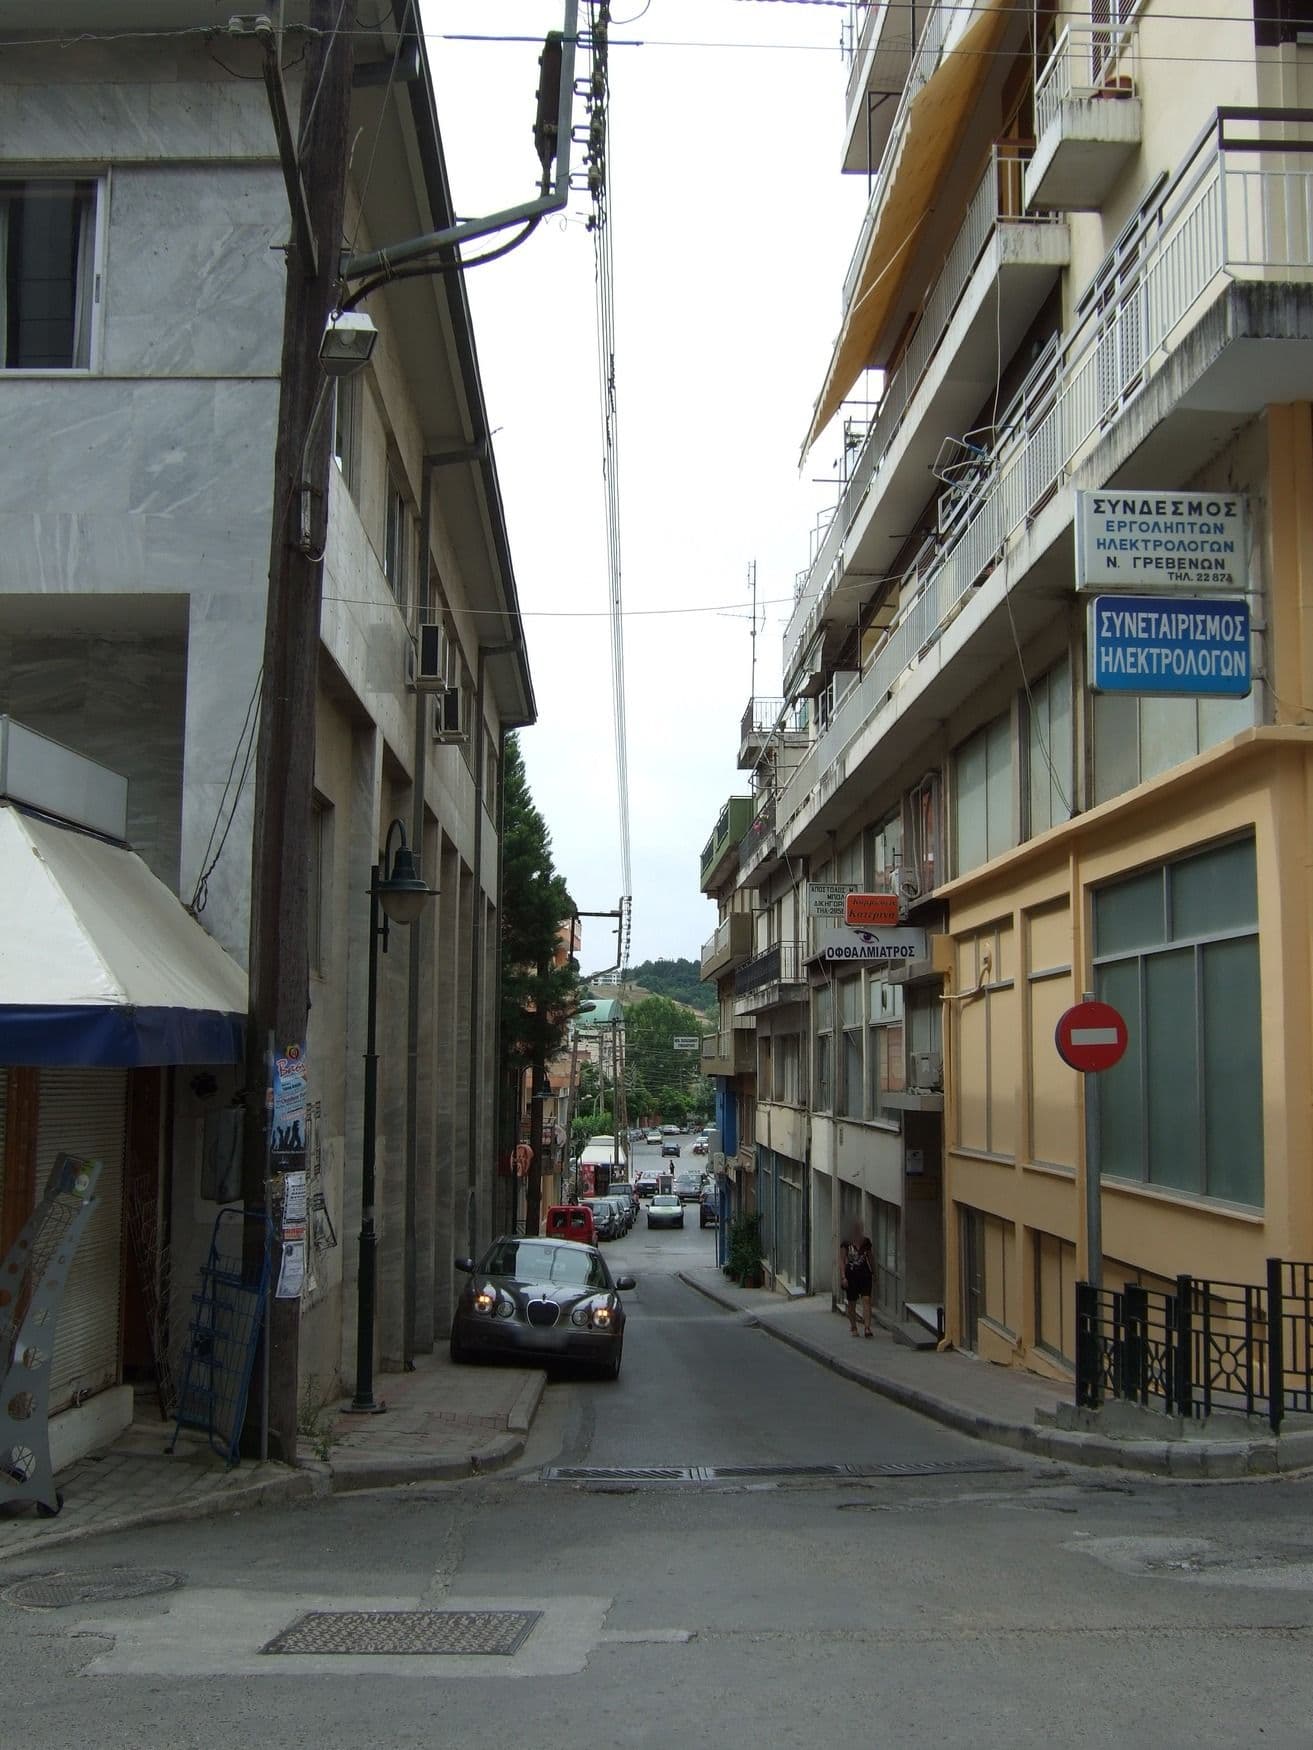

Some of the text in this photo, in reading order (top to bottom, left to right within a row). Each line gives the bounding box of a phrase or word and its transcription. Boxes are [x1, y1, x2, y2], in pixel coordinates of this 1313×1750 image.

[1093, 499, 1237, 517] ΣΥΝΔΕΣΜΟΣ
[1106, 520, 1225, 534] ΕΡΓΟΛΗΠΤΩΝ
[1097, 538, 1234, 552] ΗΛΕΚΤΡΟΛΟΓΩΝ
[1107, 556, 1225, 570] Ν. ΓΡΕΒΕΝΩΝ
[1169, 572, 1194, 581] ΤΗΛ.
[1101, 611, 1245, 641] ΣΥΝΕΤΑΙΡΙΣΜΟΣ
[1101, 647, 1246, 677] ΗΛΕΚΤΡΟΛΟΓΩΝ
[827, 946, 915, 958] ΟΦΘΑΛΜΙΑΤΡΟΣ
